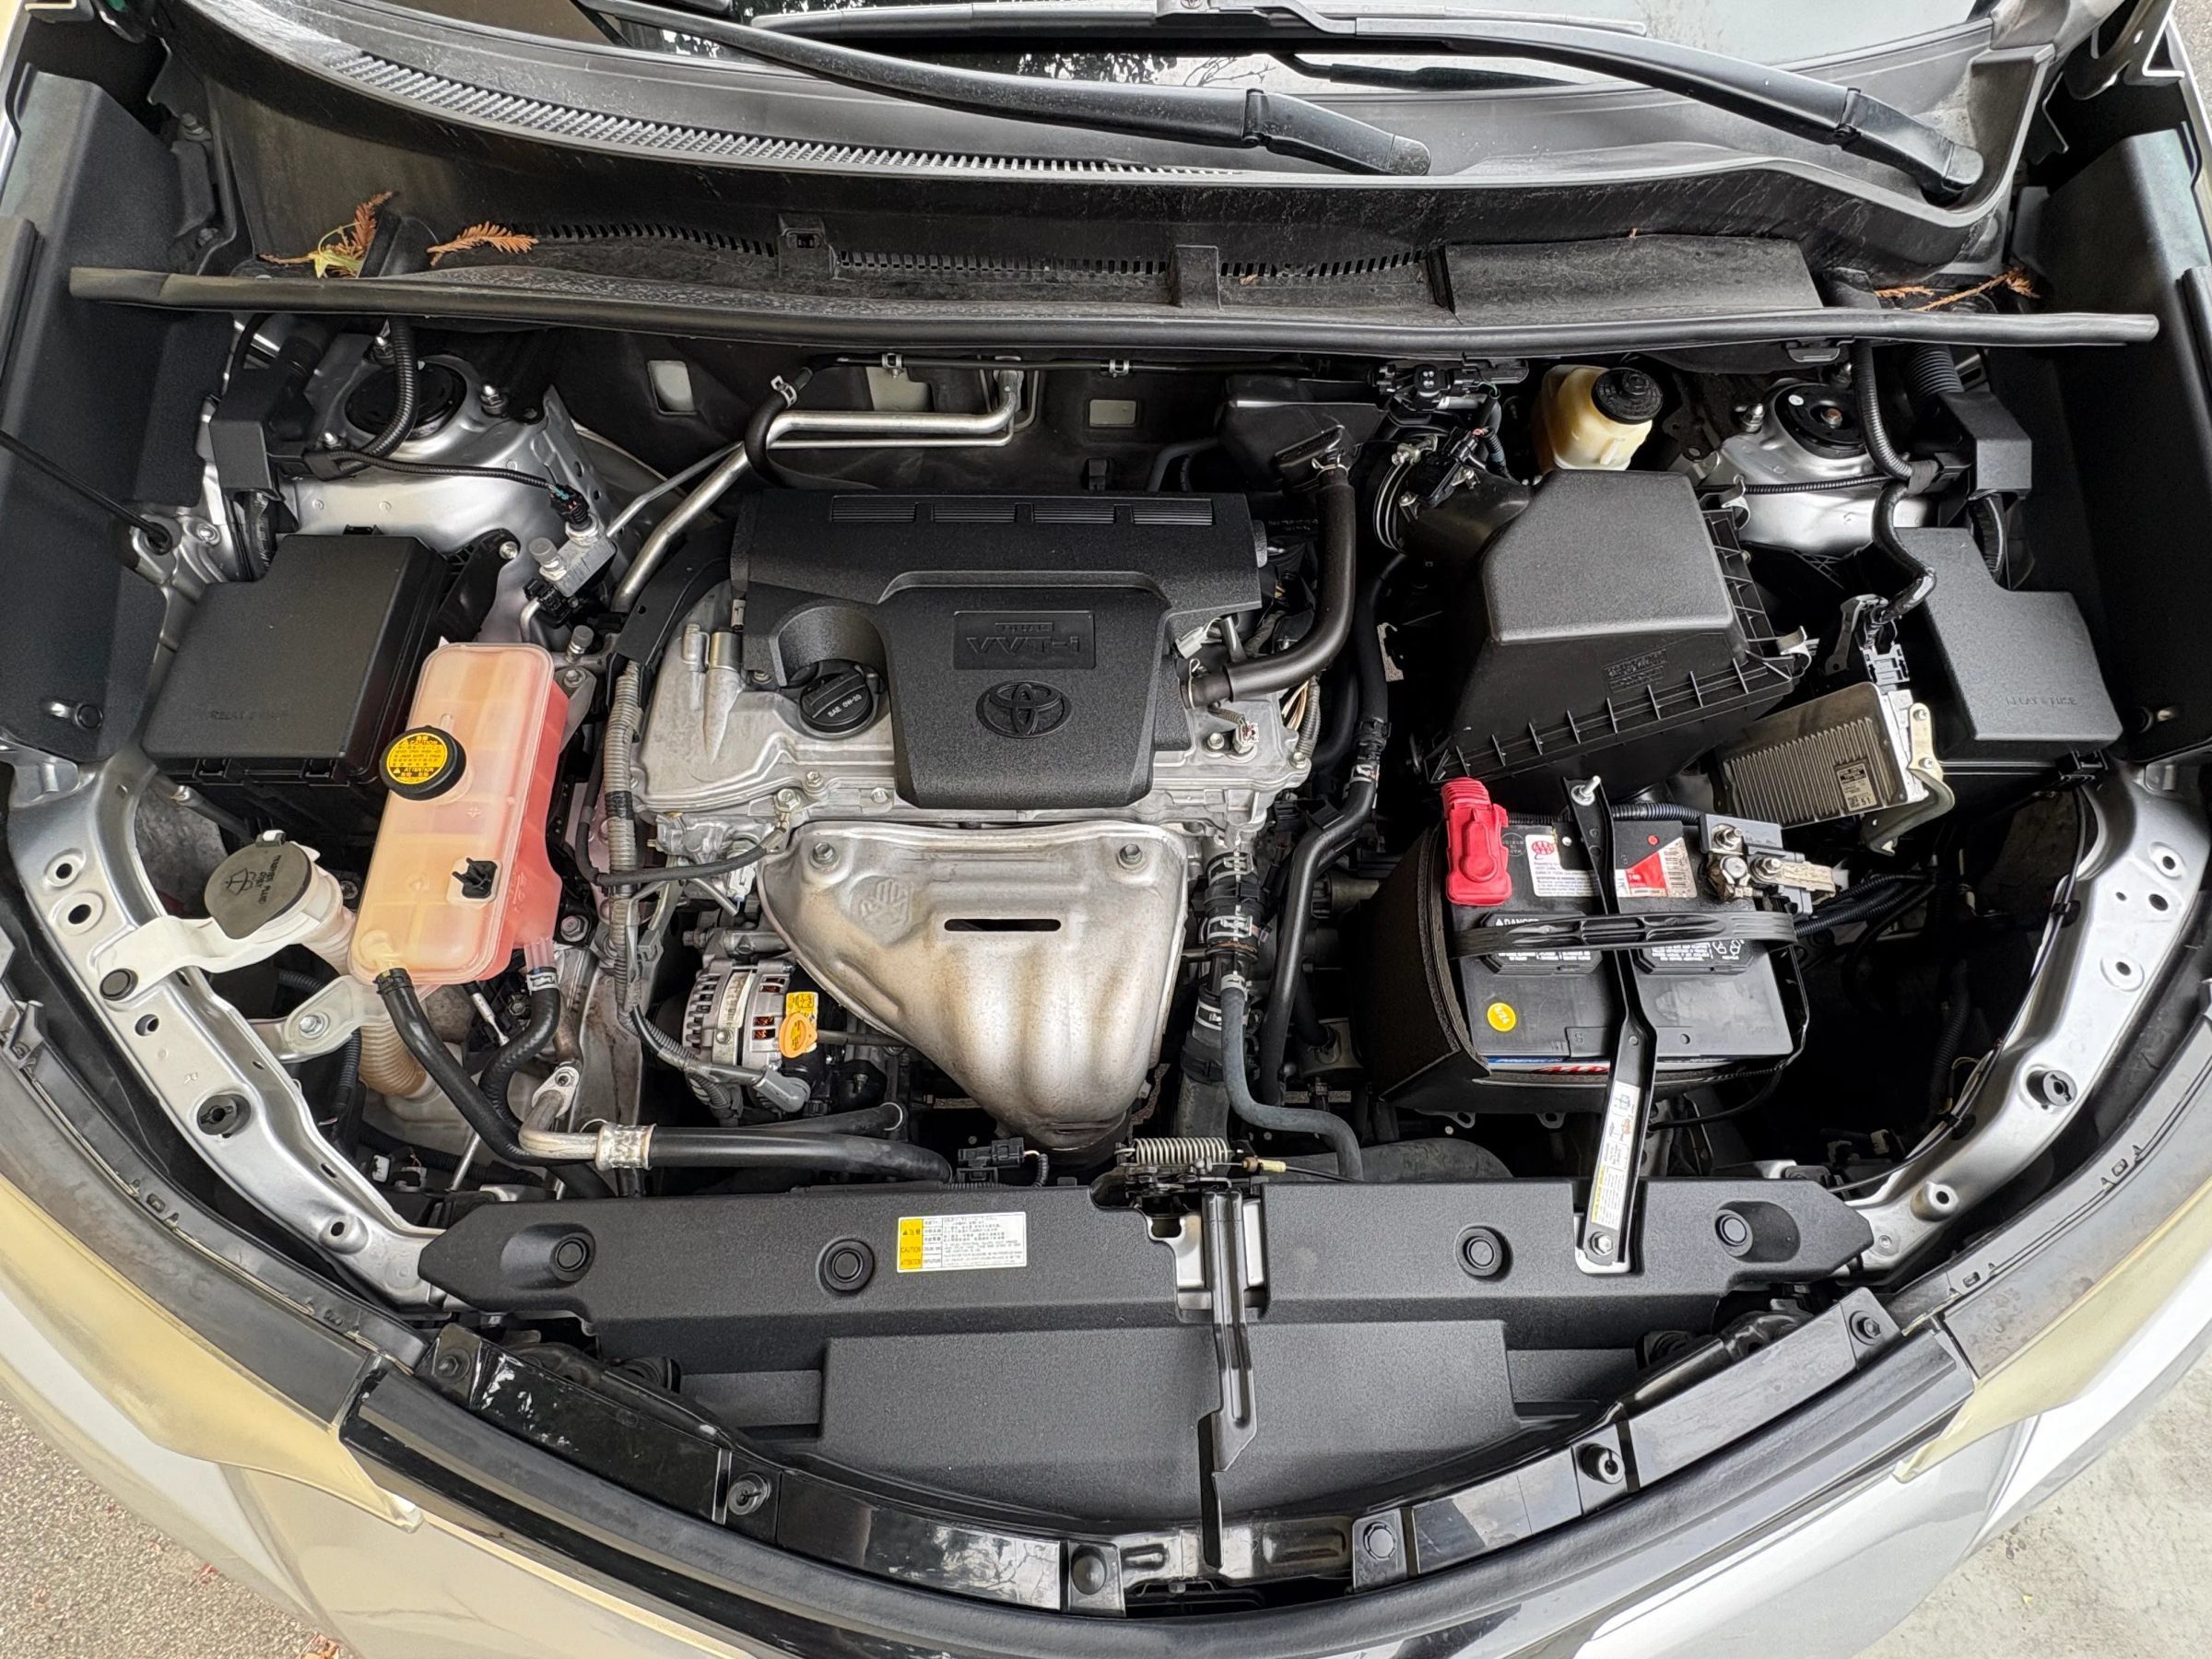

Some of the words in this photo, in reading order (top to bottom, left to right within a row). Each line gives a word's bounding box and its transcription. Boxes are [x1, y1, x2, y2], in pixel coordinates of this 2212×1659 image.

[966, 635, 1081, 655] VVT-i
[827, 705, 842, 718] SAE
[841, 693, 863, 709] 0W-20
[1861, 797, 1871, 806] 51
